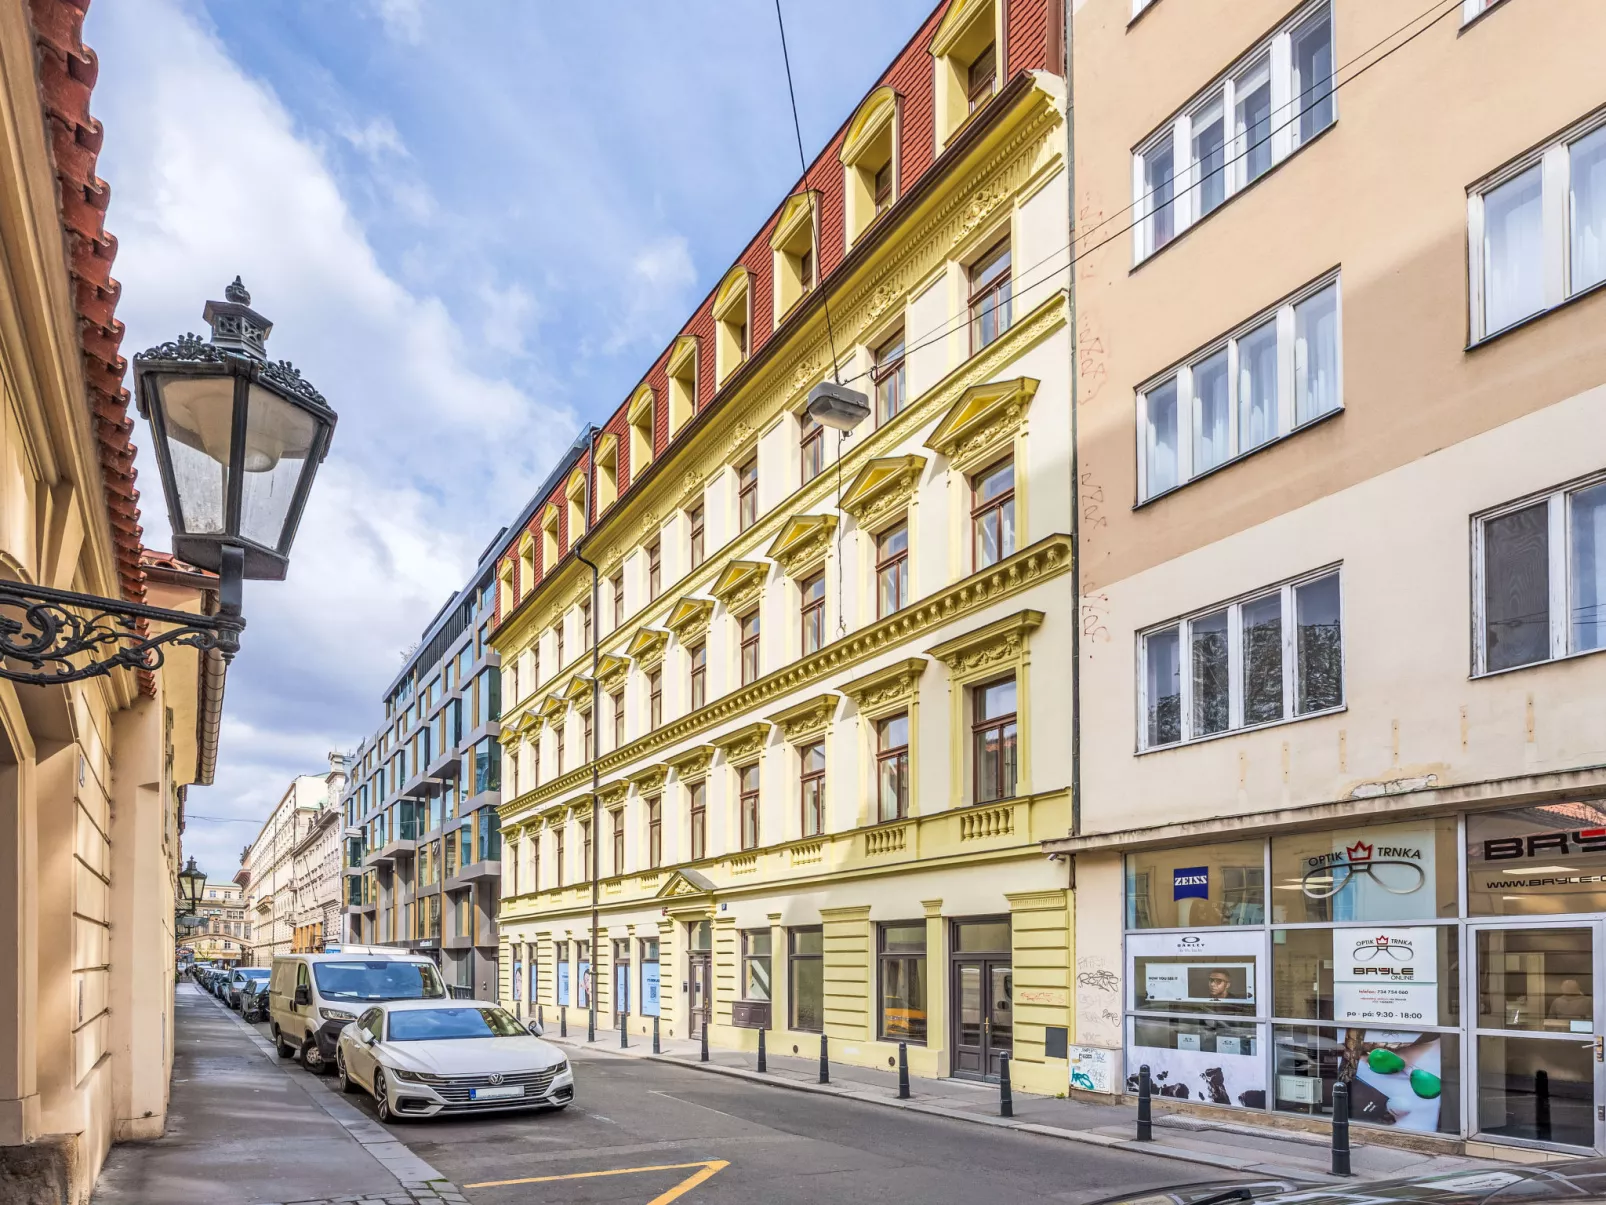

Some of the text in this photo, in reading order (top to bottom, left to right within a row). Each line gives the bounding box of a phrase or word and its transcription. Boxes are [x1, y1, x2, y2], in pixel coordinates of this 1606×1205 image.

[1308, 847, 1421, 866] OPTIK TRNKA
[1174, 875, 1208, 886] ZEISS
[1391, 938, 1413, 946] TRNKA
[1353, 967, 1414, 975] BRYLE
[1362, 1010, 1374, 1018] pá:
